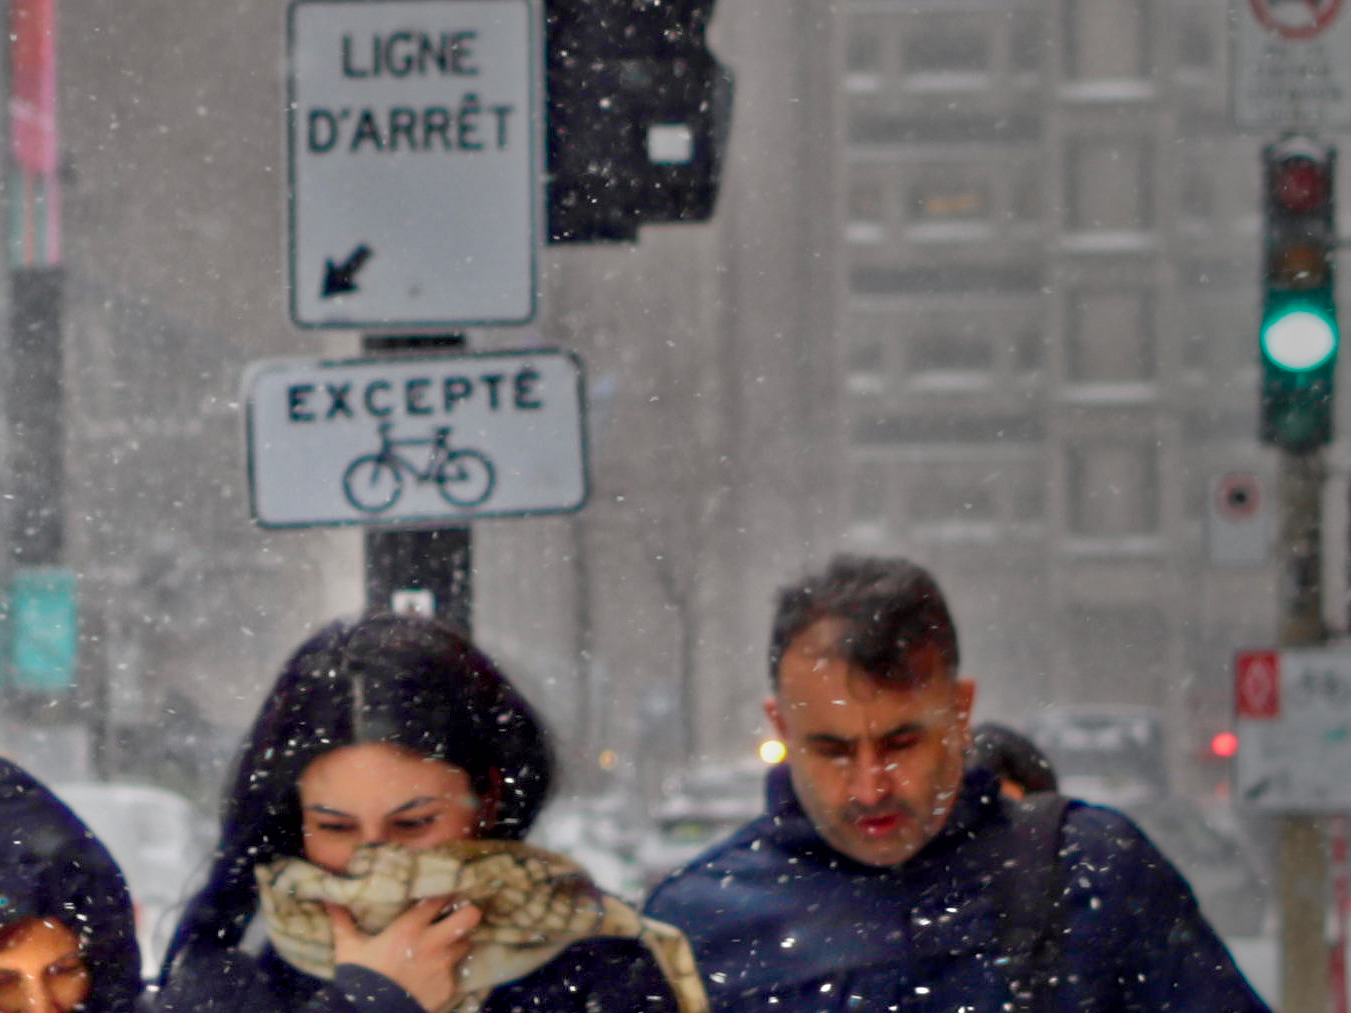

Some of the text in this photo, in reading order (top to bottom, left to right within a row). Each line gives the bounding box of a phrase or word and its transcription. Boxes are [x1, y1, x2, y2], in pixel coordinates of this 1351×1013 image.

[341, 30, 480, 79] LIGNE
[307, 93, 515, 154] D'ARRÊT
[288, 369, 544, 424] EXCEPTÉ
